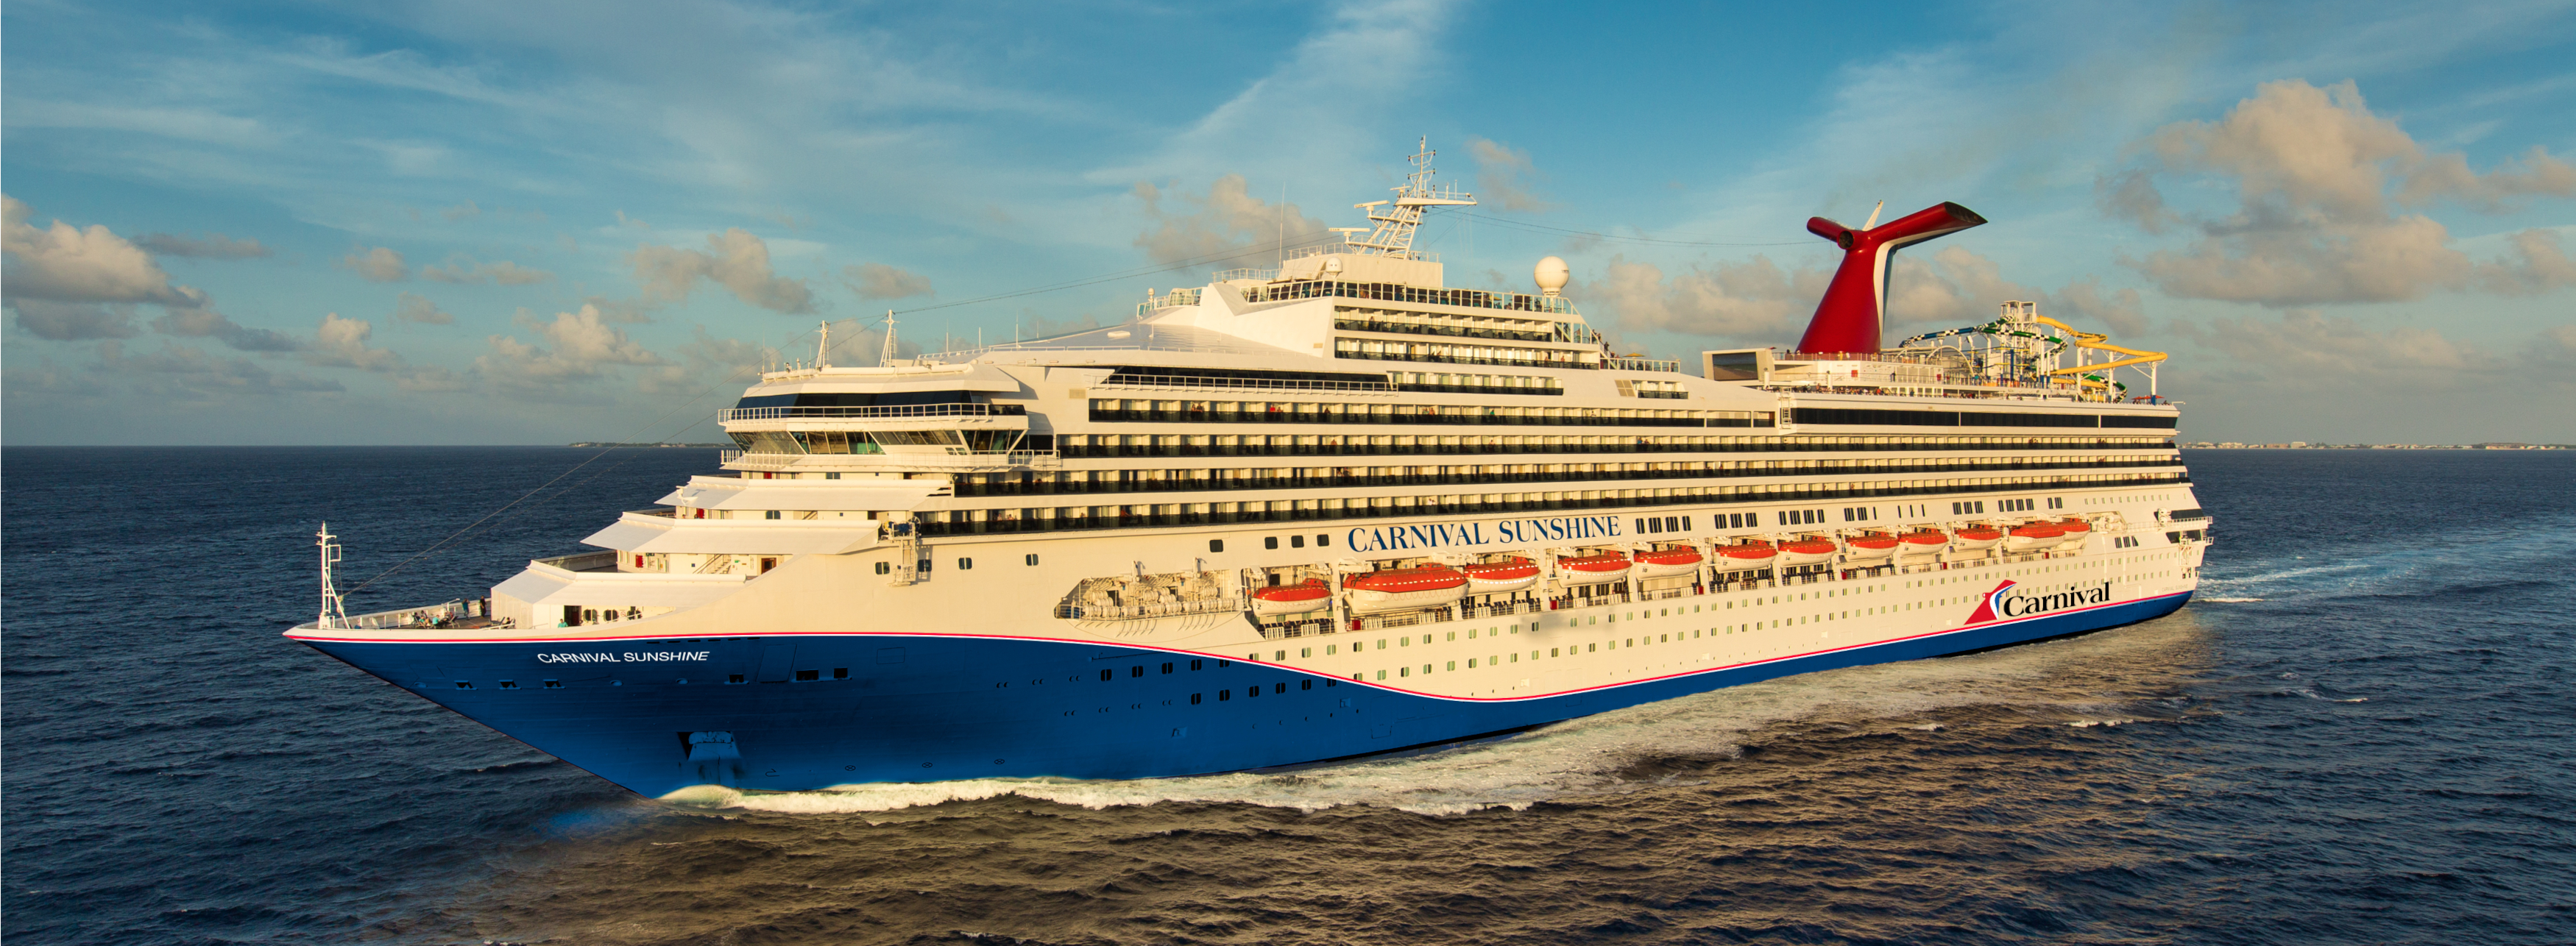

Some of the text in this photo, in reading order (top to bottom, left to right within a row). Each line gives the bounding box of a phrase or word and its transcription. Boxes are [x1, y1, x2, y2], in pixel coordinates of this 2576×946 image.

[1348, 516, 1621, 552] CARNIVAL SUNSHINE
[2003, 581, 2110, 616] Carnival
[537, 651, 710, 663] CARNIVAL SUNSHINE
